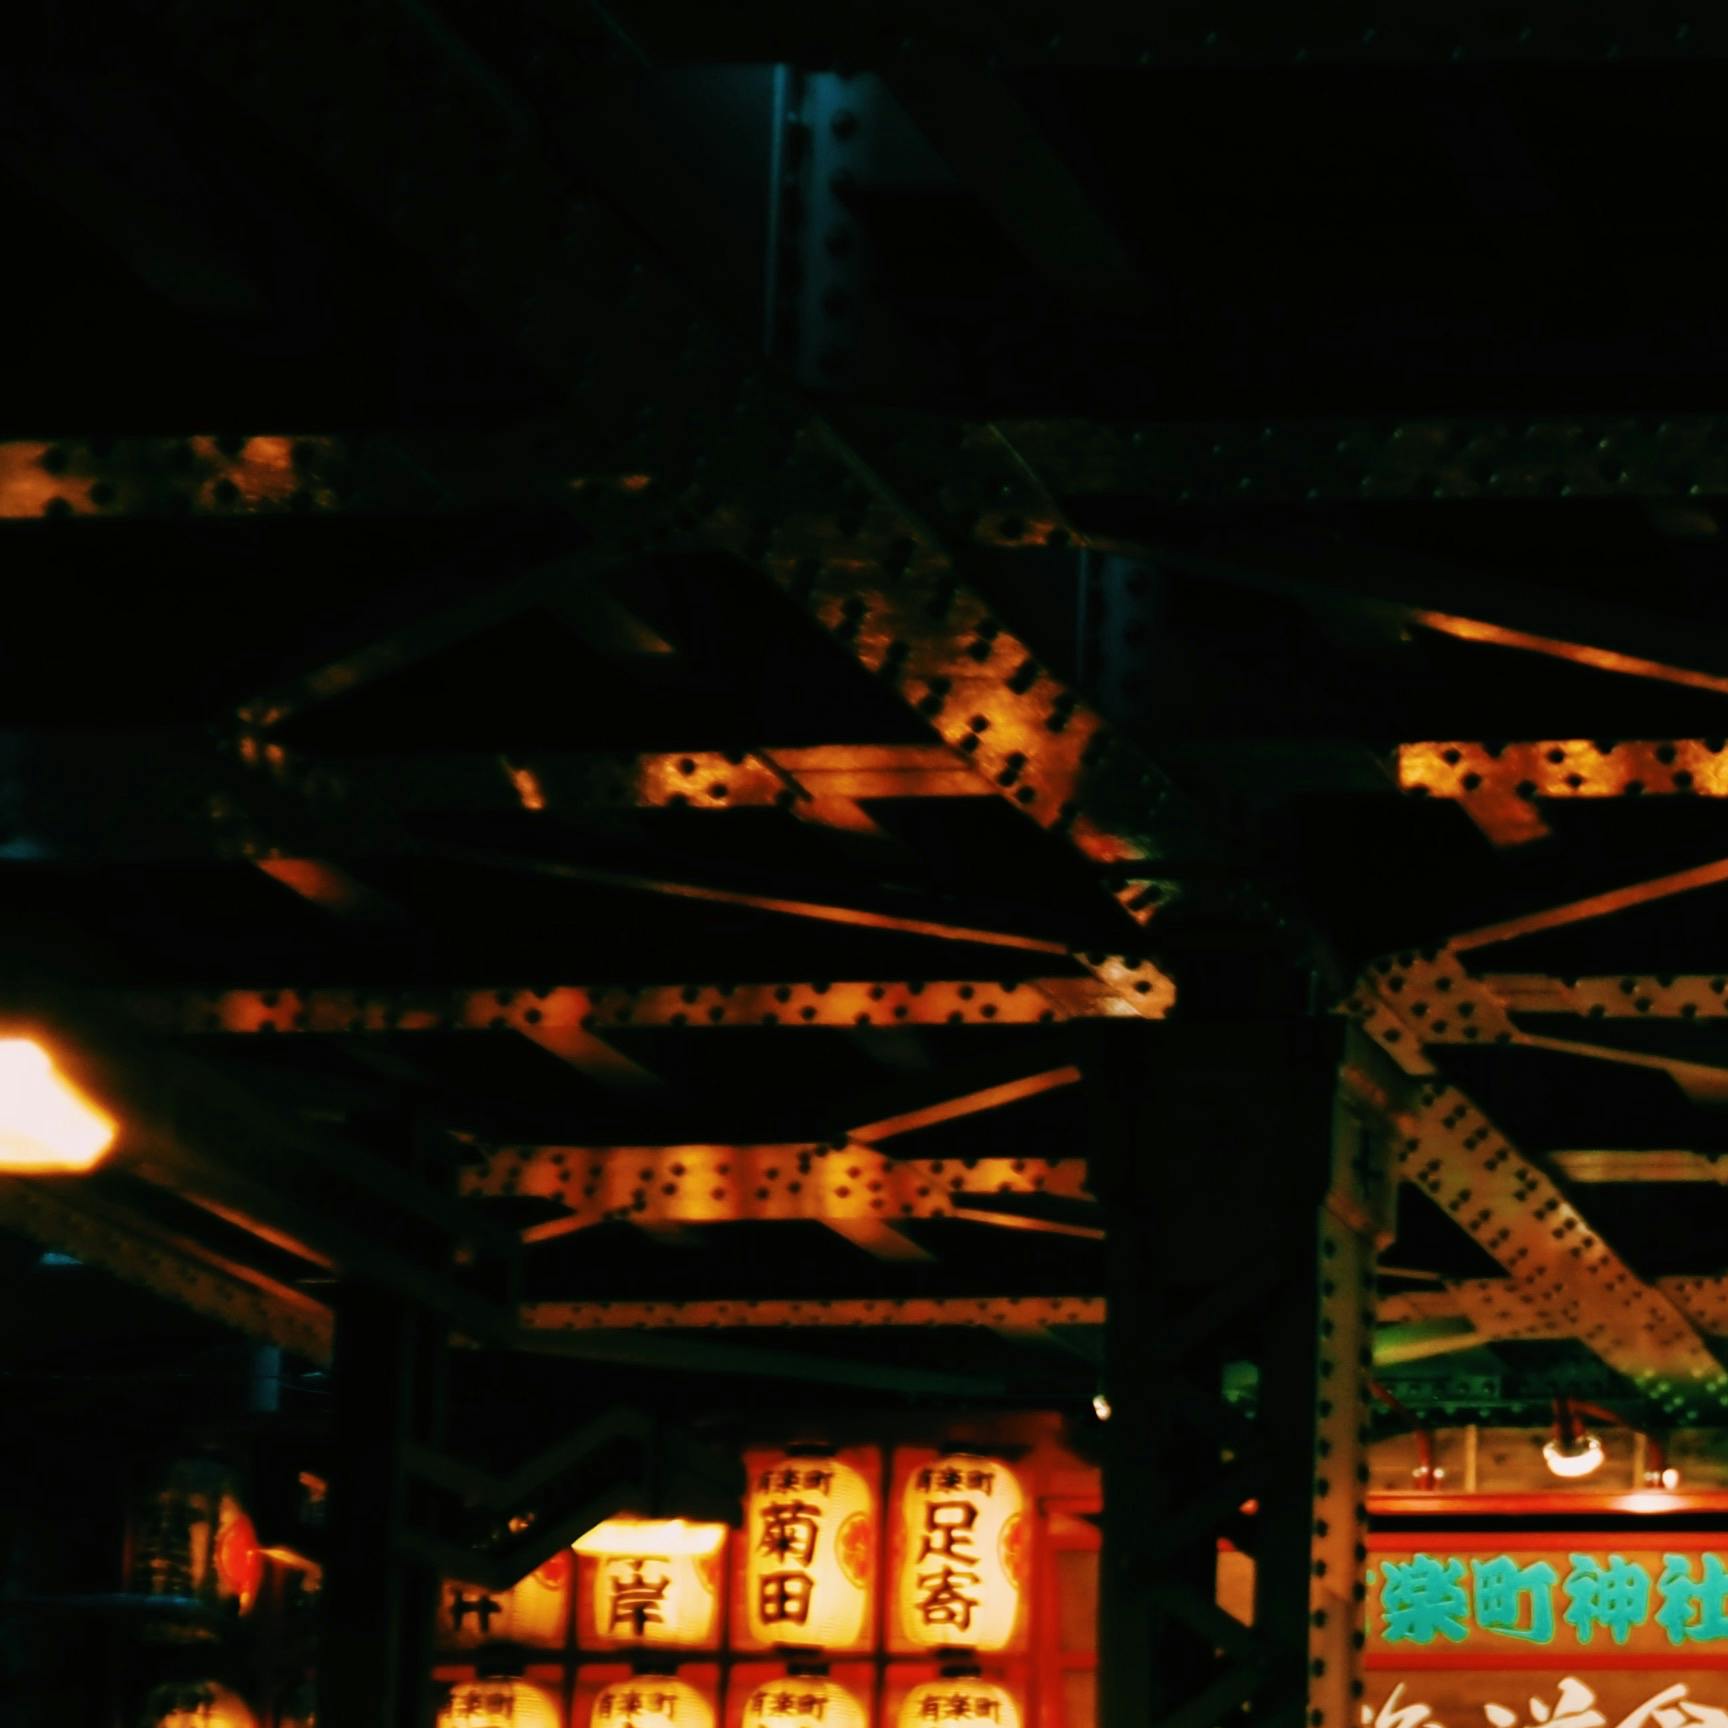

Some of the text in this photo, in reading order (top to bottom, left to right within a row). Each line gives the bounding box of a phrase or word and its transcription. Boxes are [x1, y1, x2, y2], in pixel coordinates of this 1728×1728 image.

[606, 1555, 672, 1636] 岸
[757, 1500, 823, 1627] 菊田
[916, 1501, 983, 1632] 足寄
